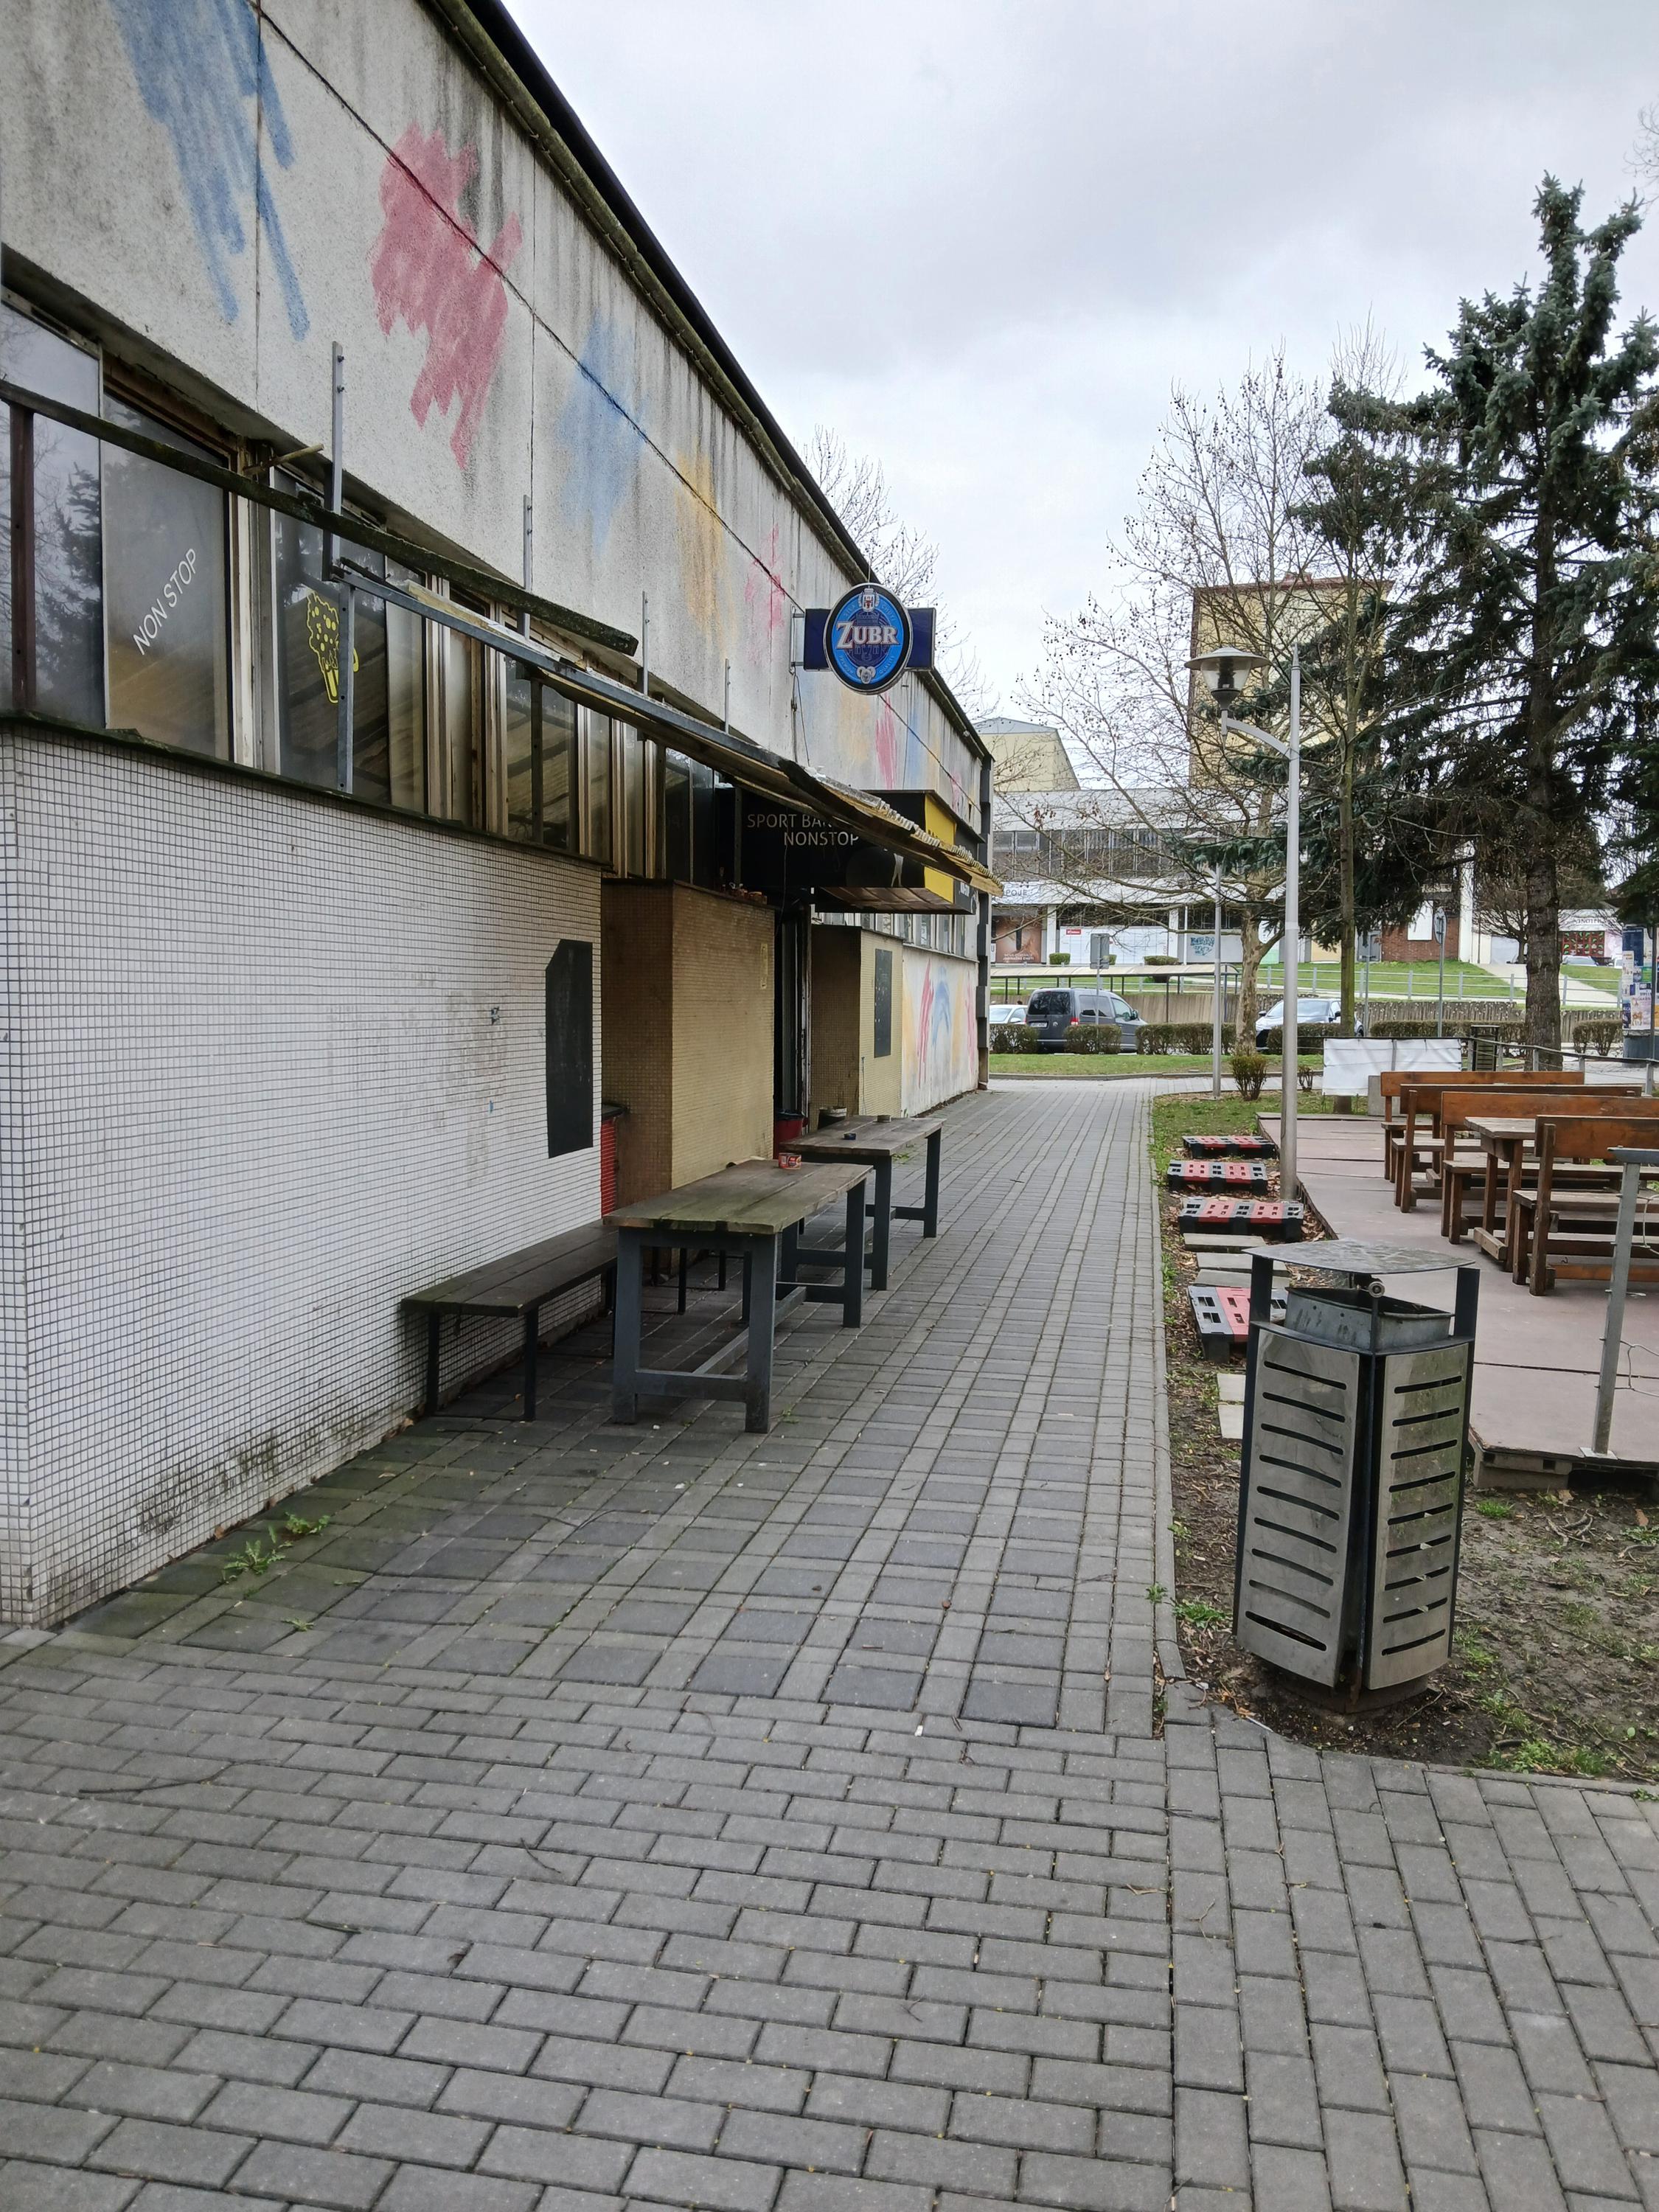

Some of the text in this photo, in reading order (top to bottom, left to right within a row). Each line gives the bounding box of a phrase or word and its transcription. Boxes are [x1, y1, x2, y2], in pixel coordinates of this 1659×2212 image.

[133, 548, 196, 655] NON STOP
[835, 620, 900, 650] ZUBR
[747, 813, 797, 828] SPORT
[784, 831, 859, 846] NONSTOP
